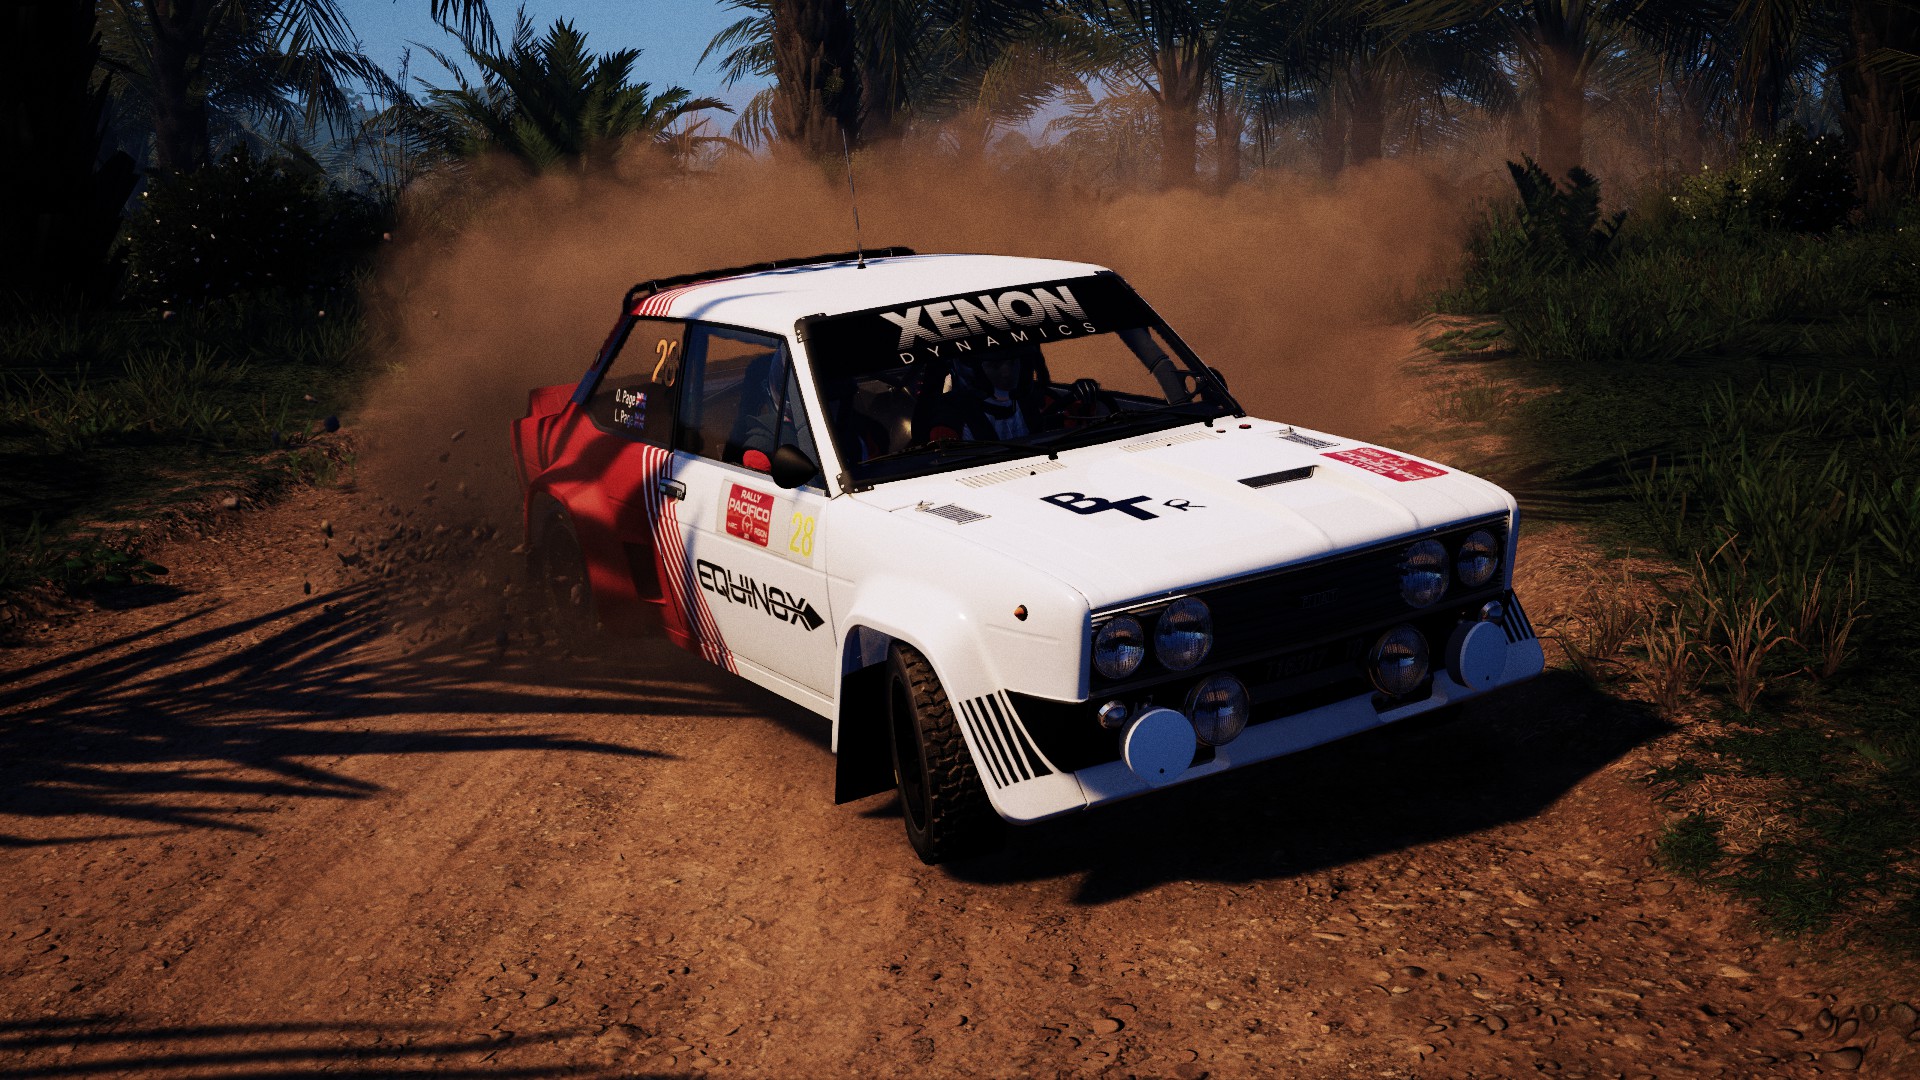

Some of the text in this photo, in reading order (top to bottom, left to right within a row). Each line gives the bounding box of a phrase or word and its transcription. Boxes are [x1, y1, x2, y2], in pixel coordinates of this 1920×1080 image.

[880, 285, 1089, 351] XENON
[899, 322, 1096, 365] DYNAMICS
[622, 389, 636, 408] Page
[1344, 459, 1387, 474] RALLY
[728, 498, 771, 523] PACIFICO
[740, 489, 762, 503] RALLY
[789, 512, 815, 557] 28
[697, 559, 812, 632] EQUINOX
